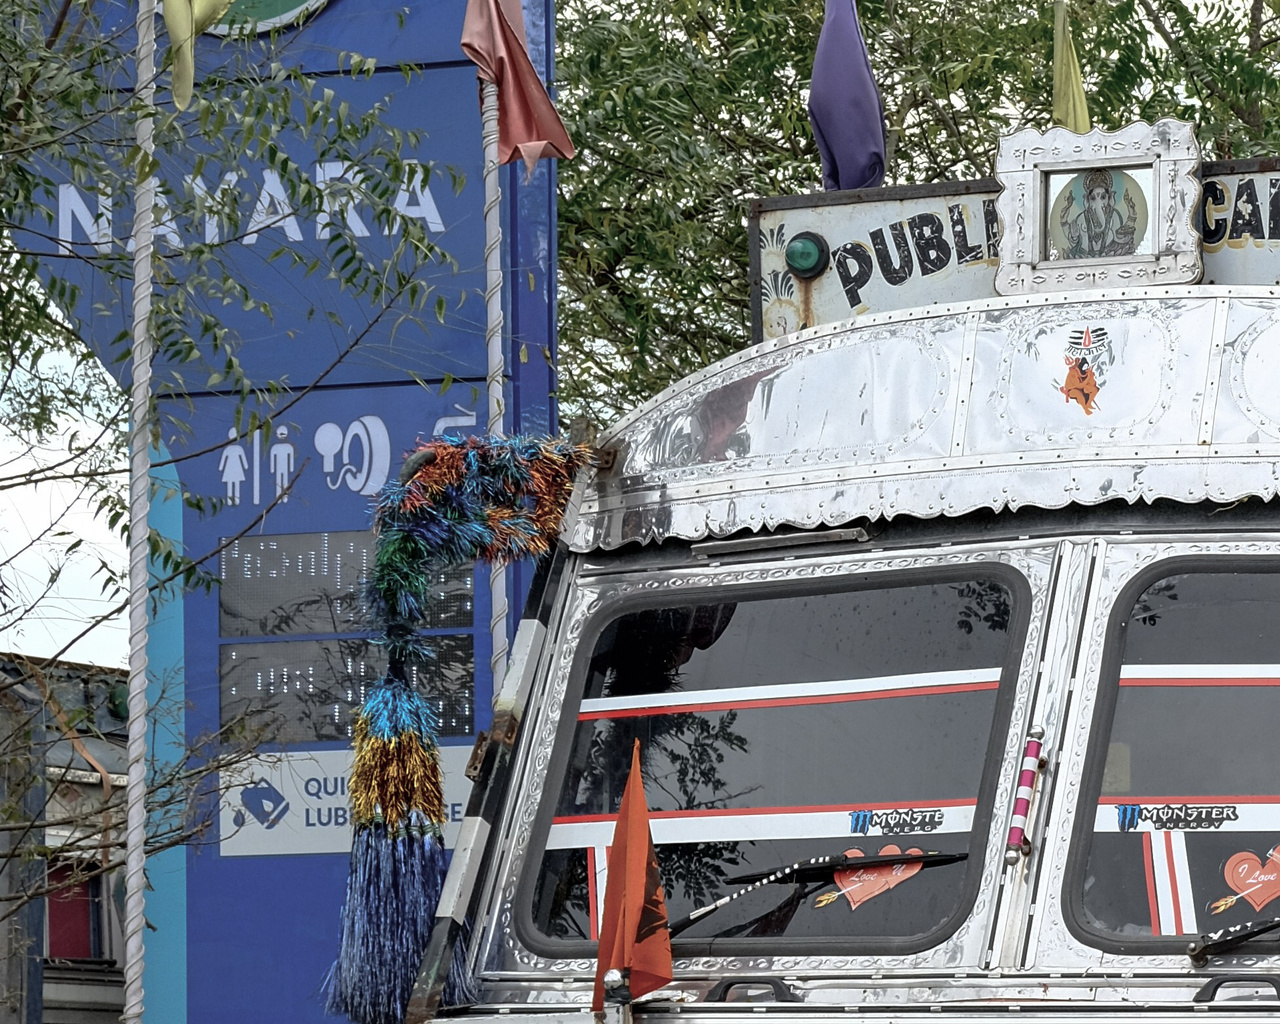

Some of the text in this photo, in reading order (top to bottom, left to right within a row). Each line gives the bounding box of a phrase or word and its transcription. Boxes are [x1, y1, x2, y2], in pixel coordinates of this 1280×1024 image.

[57, 158, 447, 255] NAYARA
[831, 199, 1001, 310] PUBLI
[303, 776, 348, 800] QUI
[305, 806, 351, 828] LUB
[871, 809, 945, 828] MONSTE
[1155, 821, 1222, 829] ENERGY
[849, 869, 878, 881] Love
[1245, 870, 1278, 884] Love
